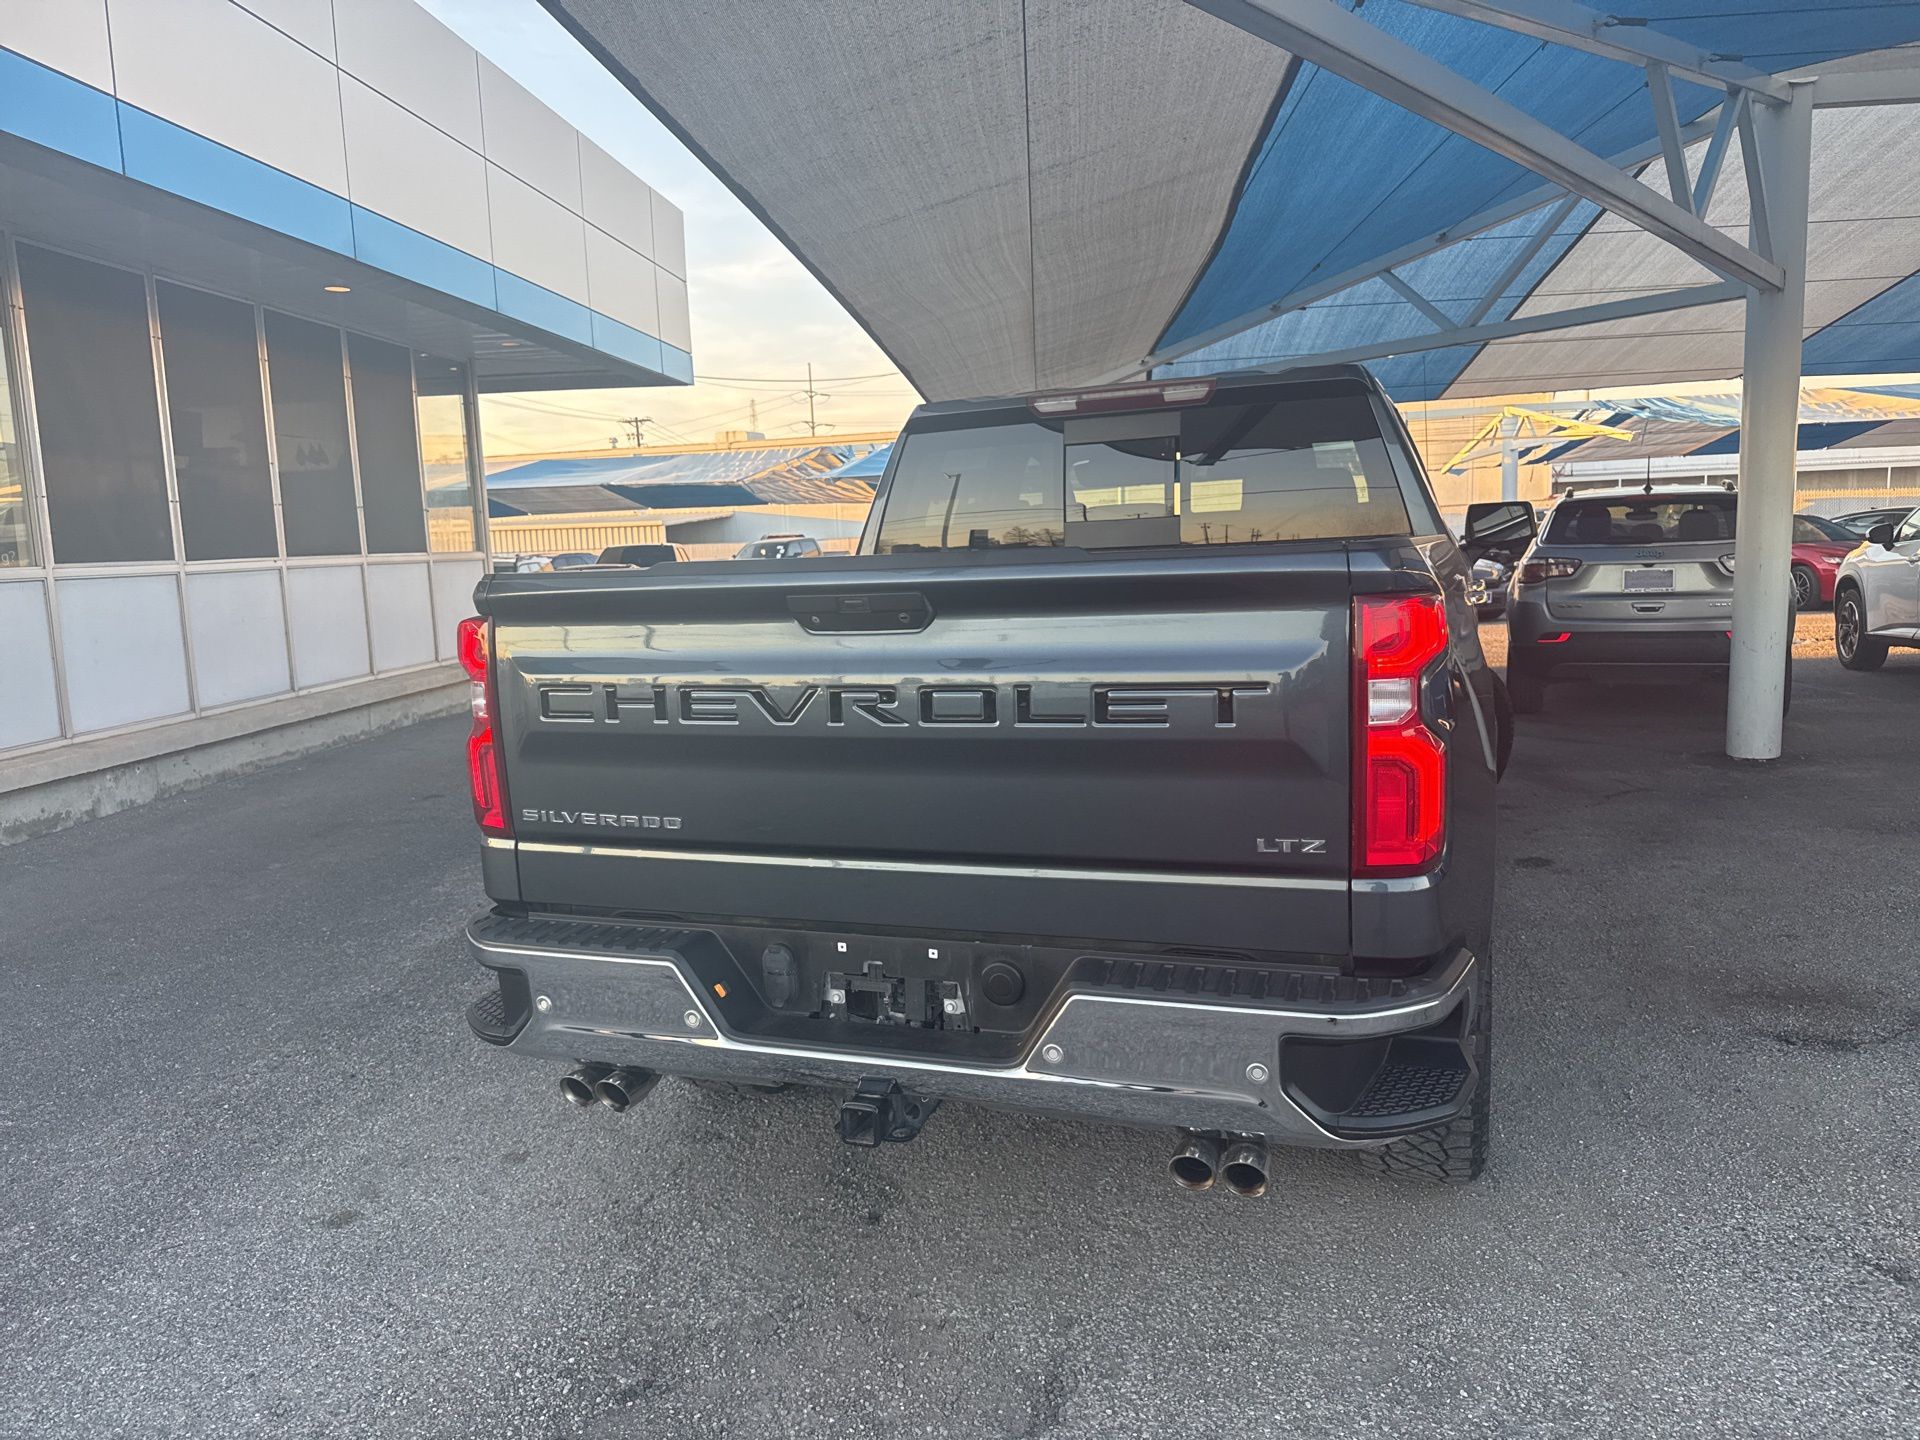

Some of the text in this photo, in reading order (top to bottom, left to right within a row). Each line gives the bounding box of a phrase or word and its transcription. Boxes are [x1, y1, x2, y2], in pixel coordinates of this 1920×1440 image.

[538, 682, 1272, 727] CHEVROLET
[522, 809, 682, 830] SILVERADO
[1256, 838, 1327, 853] LTZ
